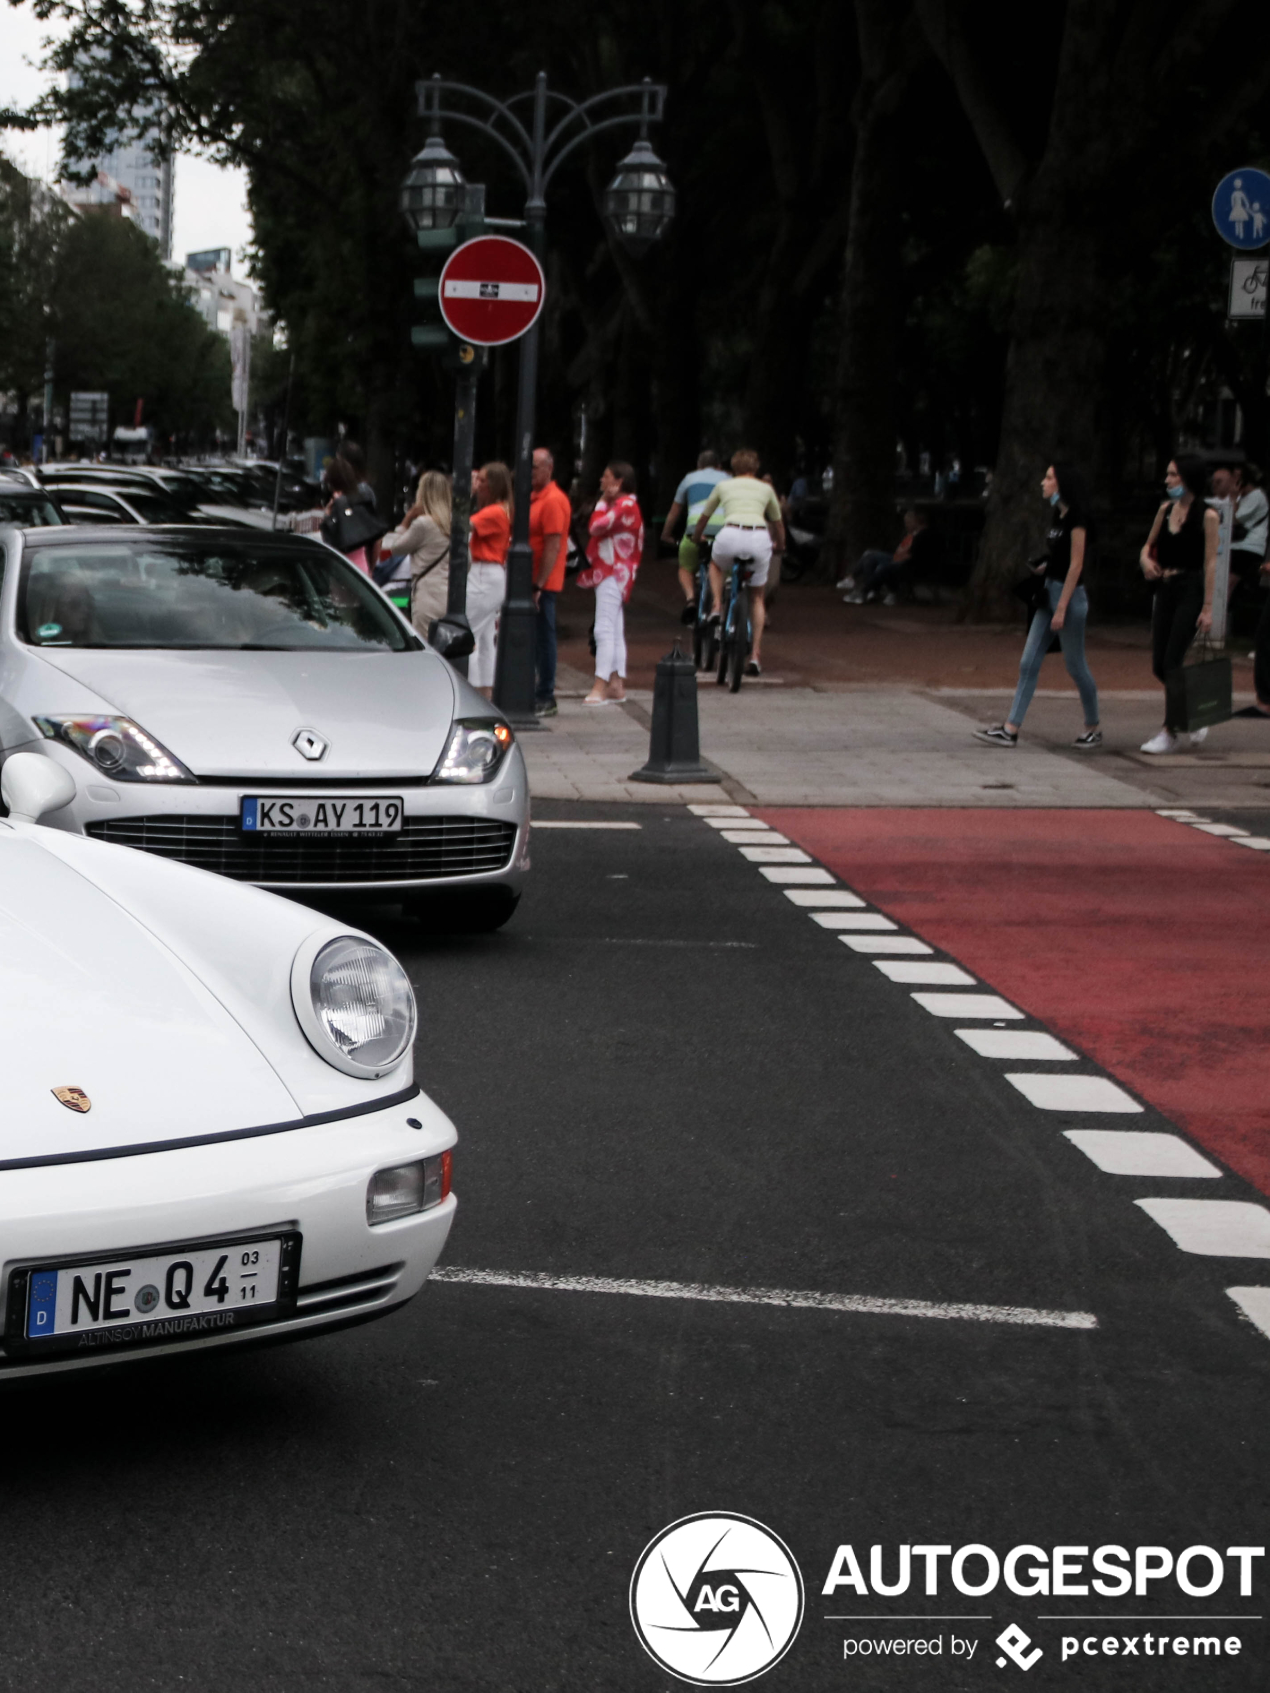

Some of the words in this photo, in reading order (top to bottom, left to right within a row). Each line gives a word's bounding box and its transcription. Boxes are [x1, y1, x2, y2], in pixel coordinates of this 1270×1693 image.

[246, 817, 253, 826] D
[260, 802, 294, 828] KS
[313, 803, 347, 828] AY
[352, 803, 400, 828] 119
[241, 1250, 260, 1266] 03
[71, 1268, 132, 1325] NE
[165, 1260, 194, 1310] Q
[203, 1254, 229, 1303] 4
[240, 1283, 258, 1300] 11
[35, 1310, 48, 1326] D
